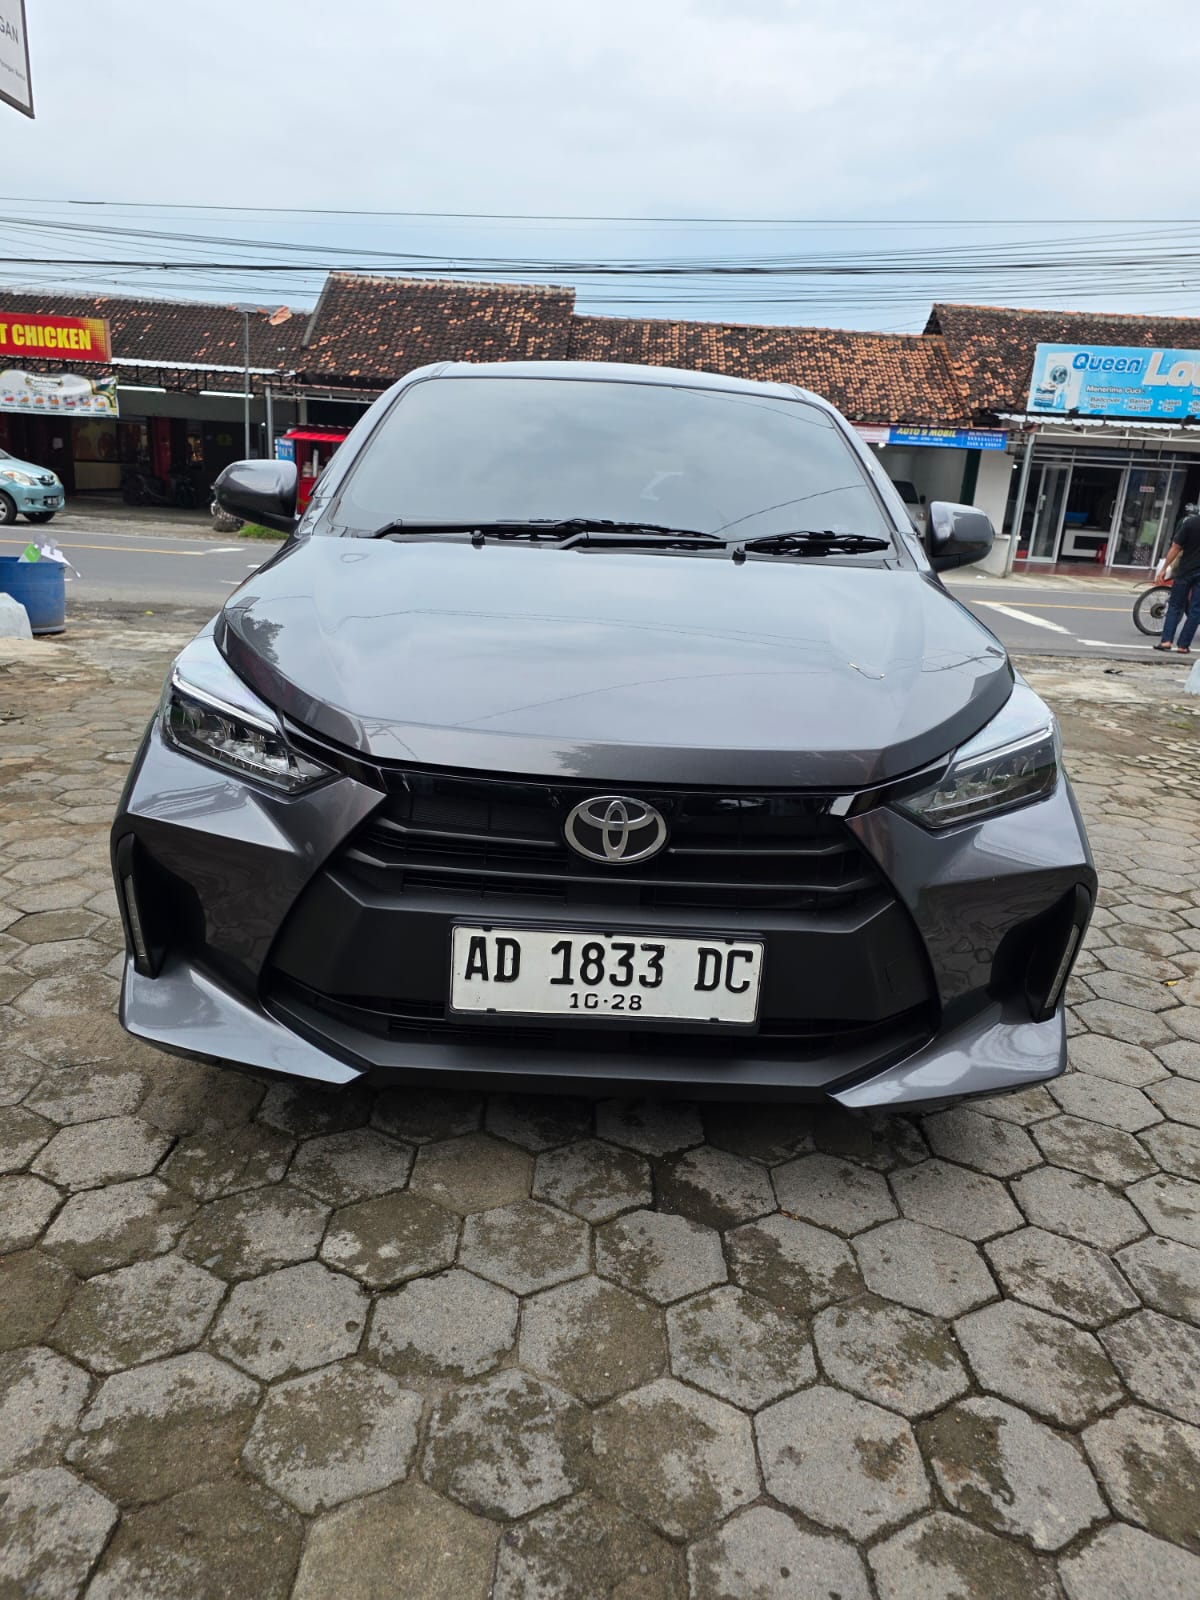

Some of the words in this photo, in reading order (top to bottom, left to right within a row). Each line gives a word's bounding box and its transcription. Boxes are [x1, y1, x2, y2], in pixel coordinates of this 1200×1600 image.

[11, 324, 92, 350] CHICKEN
[1072, 352, 1142, 373] Queen
[896, 427, 920, 436] AUTO
[929, 429, 957, 438] MOBIL
[464, 936, 521, 983] AD
[550, 940, 666, 989] 1833
[694, 947, 754, 994] DC
